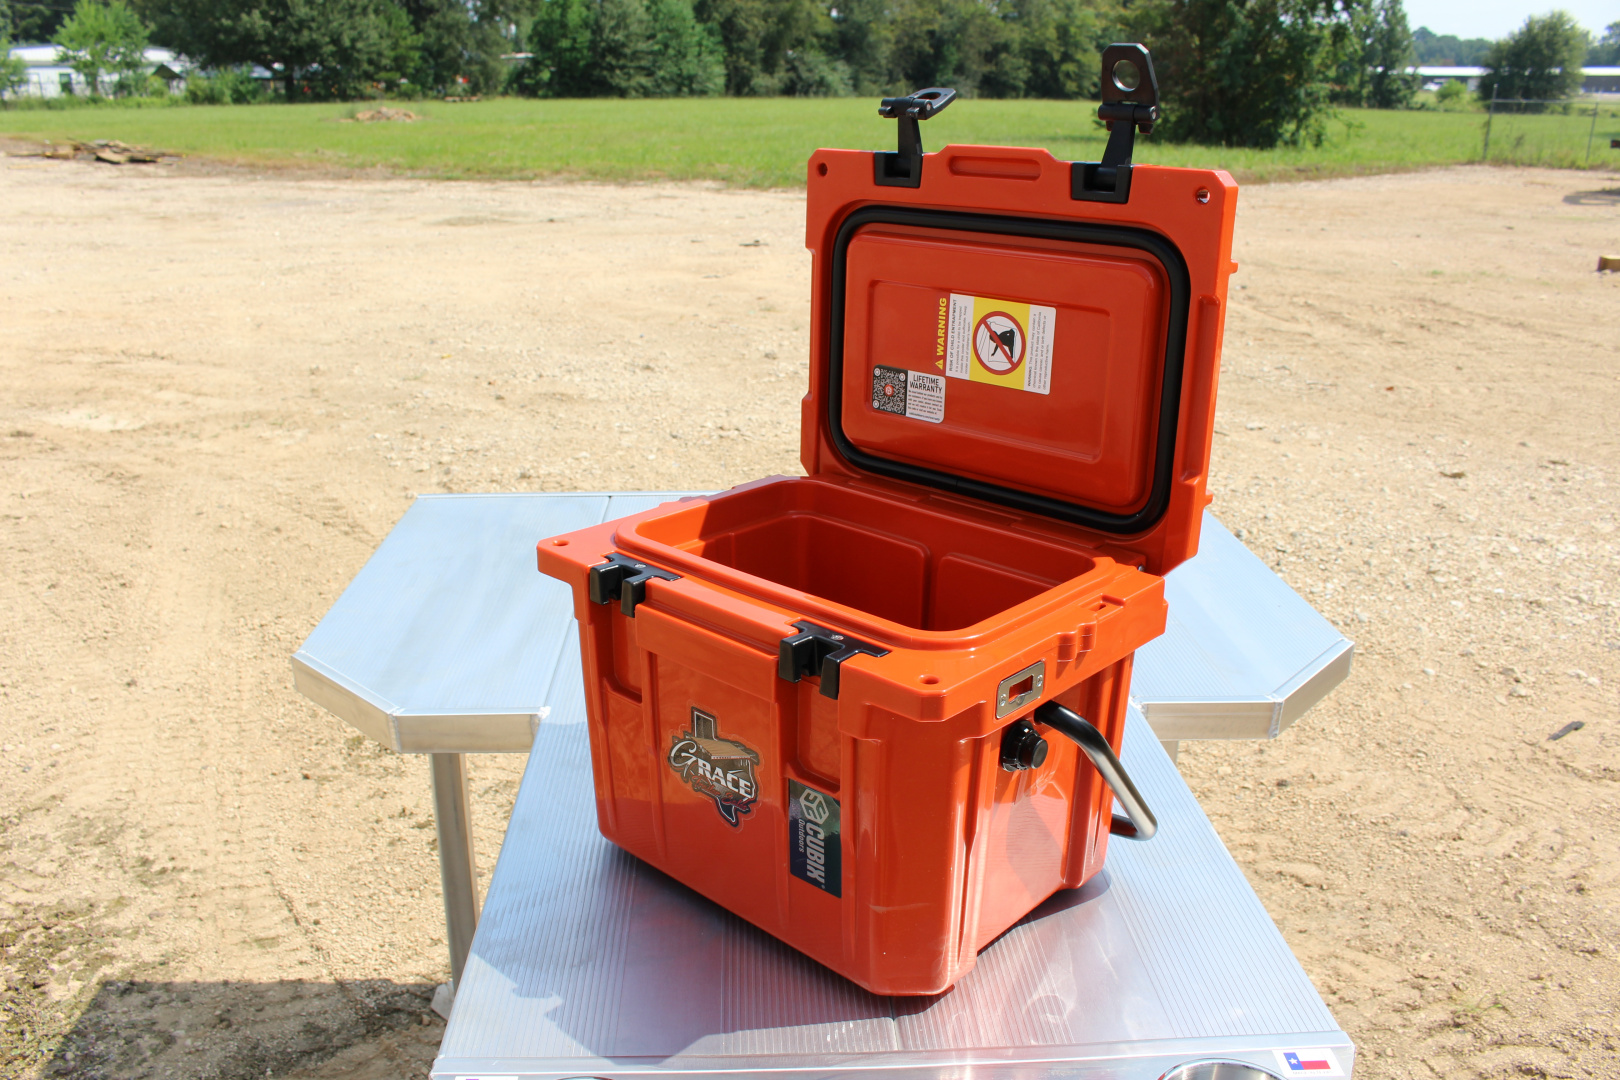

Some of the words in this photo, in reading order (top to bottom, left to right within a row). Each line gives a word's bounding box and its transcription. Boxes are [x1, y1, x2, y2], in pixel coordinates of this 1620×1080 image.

[937, 298, 946, 356] WARNING
[910, 382, 942, 393] WARRANTY
[914, 375, 939, 385] LIFETIME
[670, 740, 752, 798] GRACE
[806, 823, 825, 884] CUBIX
